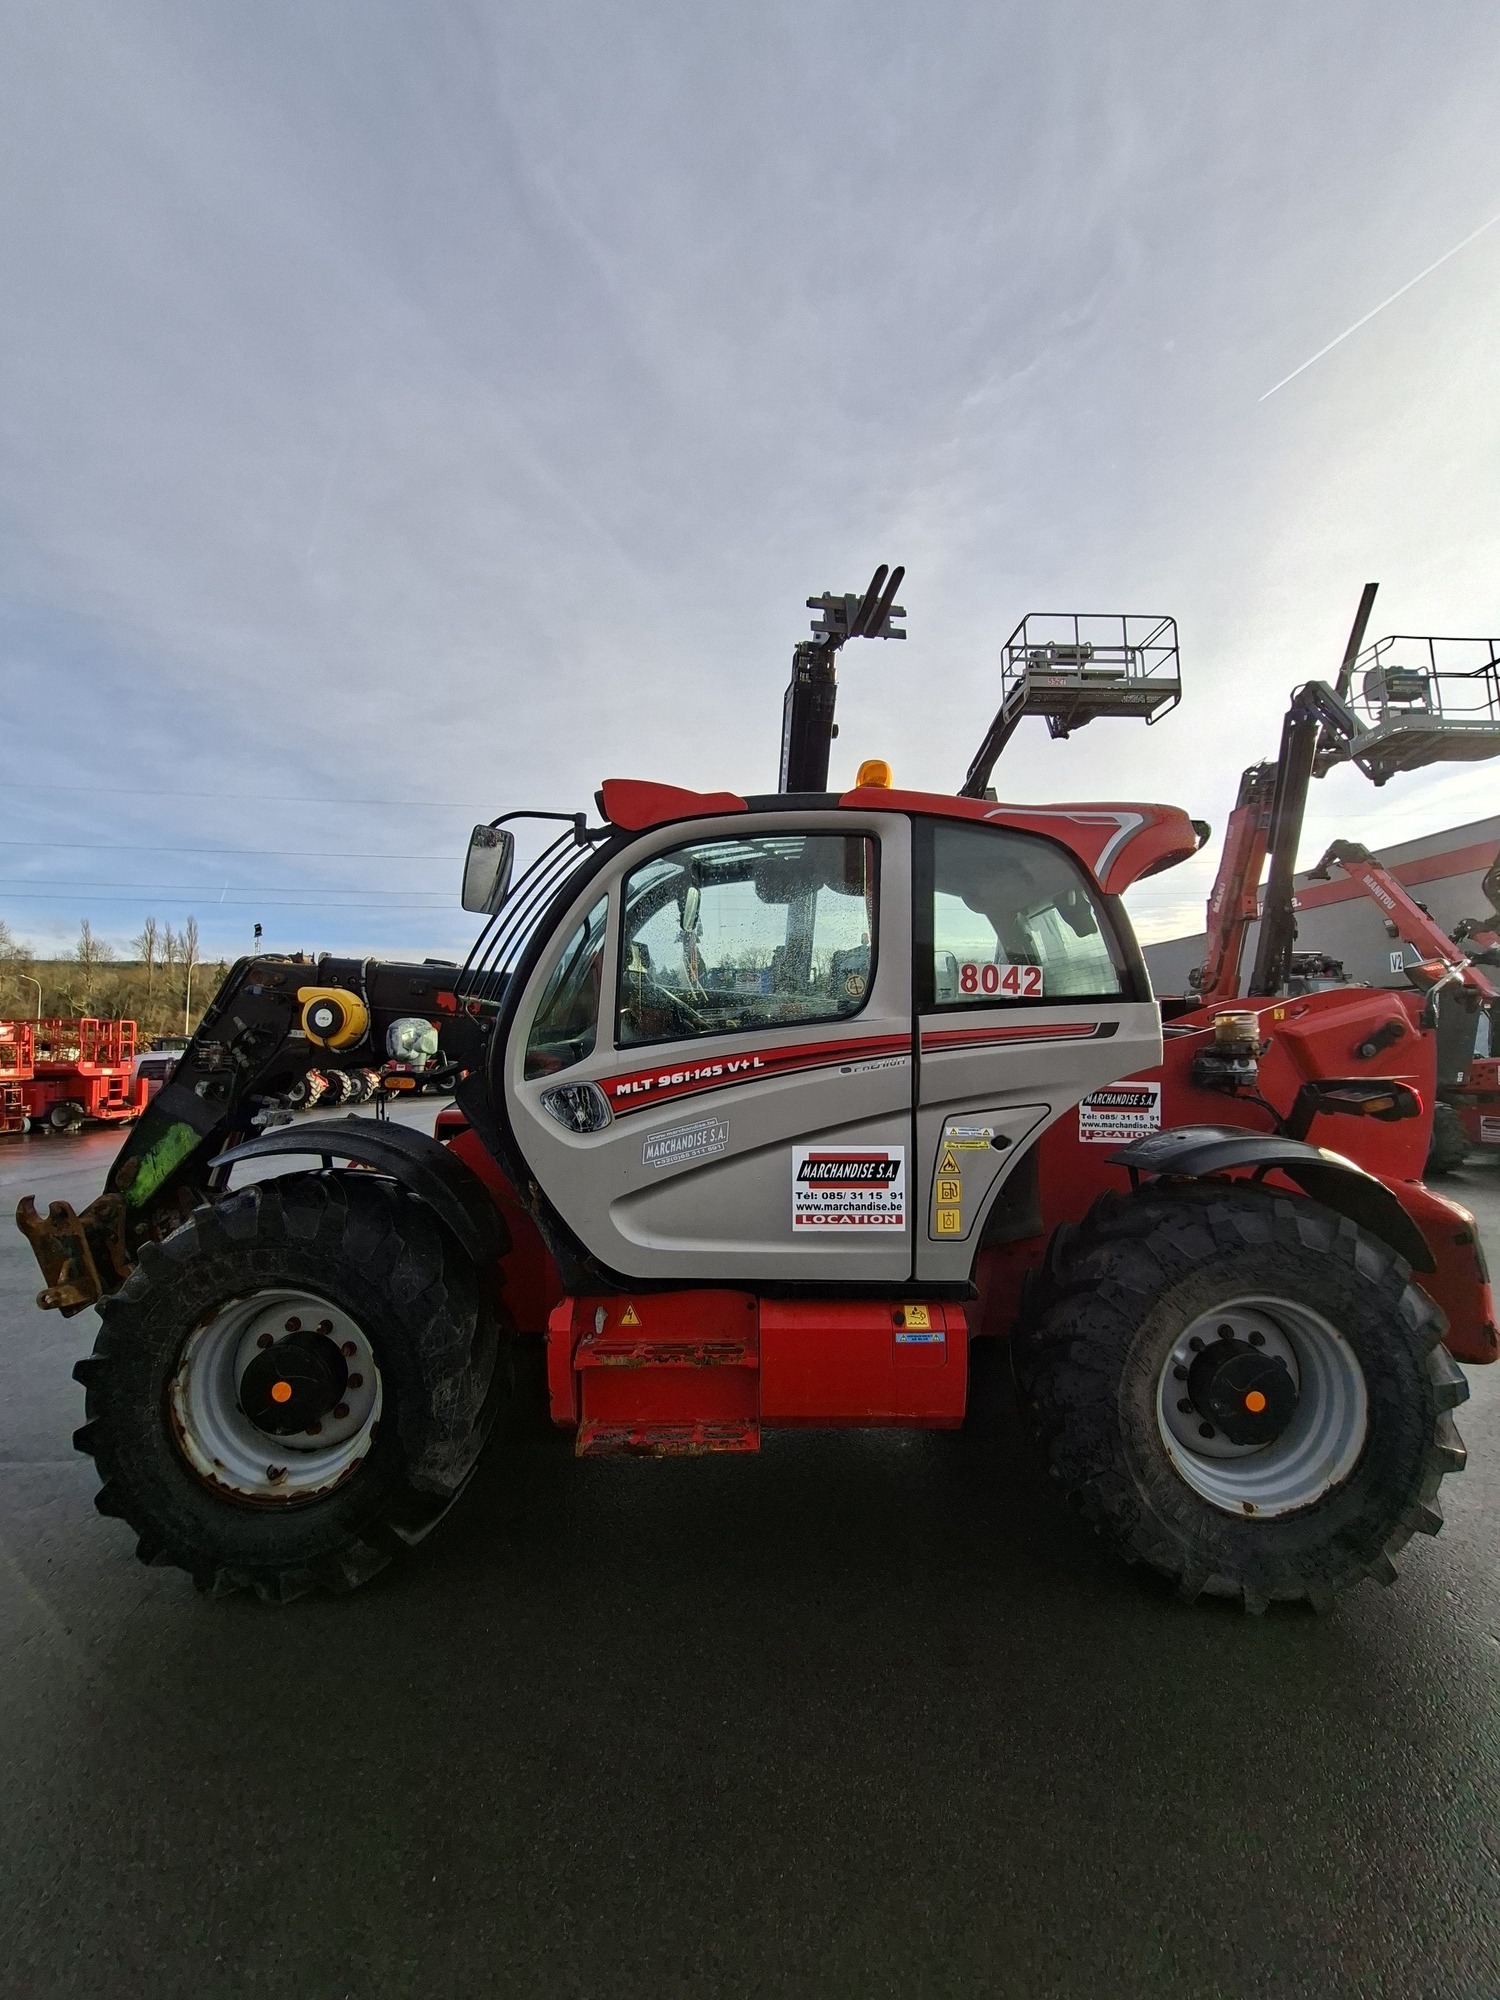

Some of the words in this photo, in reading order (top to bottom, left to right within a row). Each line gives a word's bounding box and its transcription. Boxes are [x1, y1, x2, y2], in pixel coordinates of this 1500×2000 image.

[1362, 874, 1396, 910] MANITOU
[1391, 954, 1403, 970] V2
[960, 963, 1042, 996] 8042
[616, 1078, 653, 1096] MLT
[1084, 1092, 1140, 1106] MARCHANDISE
[1139, 1094, 1154, 1106] S.A.
[1081, 1121, 1160, 1130] www.marchandise.be
[646, 1130, 707, 1159] MARCHANDISE
[709, 1127, 726, 1142] S.A.
[800, 1163, 876, 1178] MARCHANDISE
[876, 1163, 896, 1178] S.A.
[795, 1192, 818, 1200] Tél:
[821, 1191, 847, 1200] 085/
[850, 1192, 863, 1200] 31
[869, 1192, 883, 1200] 15
[889, 1192, 904, 1200] 91
[796, 1201, 903, 1211] www.marchandise.be
[802, 1215, 897, 1224] LOCATION
